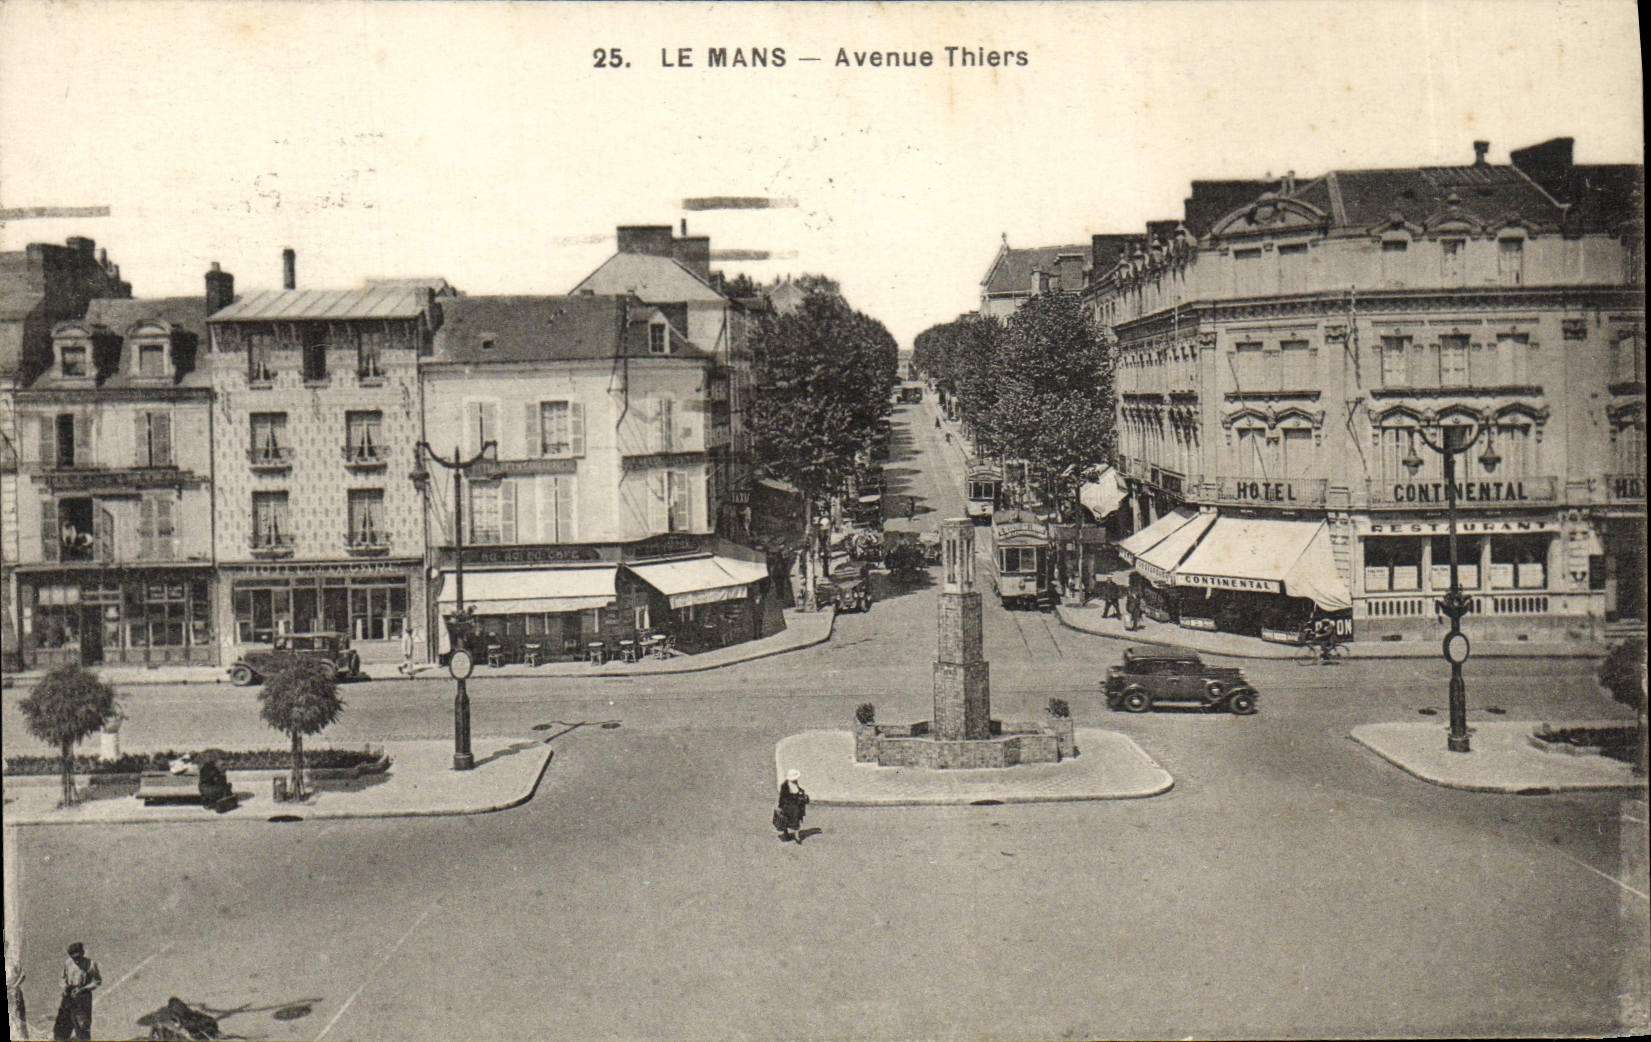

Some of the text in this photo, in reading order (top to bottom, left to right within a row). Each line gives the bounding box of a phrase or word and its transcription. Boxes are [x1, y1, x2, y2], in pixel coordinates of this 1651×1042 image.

[1237, 481, 1297, 501] HOTEL
[1394, 481, 1529, 502] CONTINENTAL
[1184, 575, 1271, 590] CONTINENTAL
